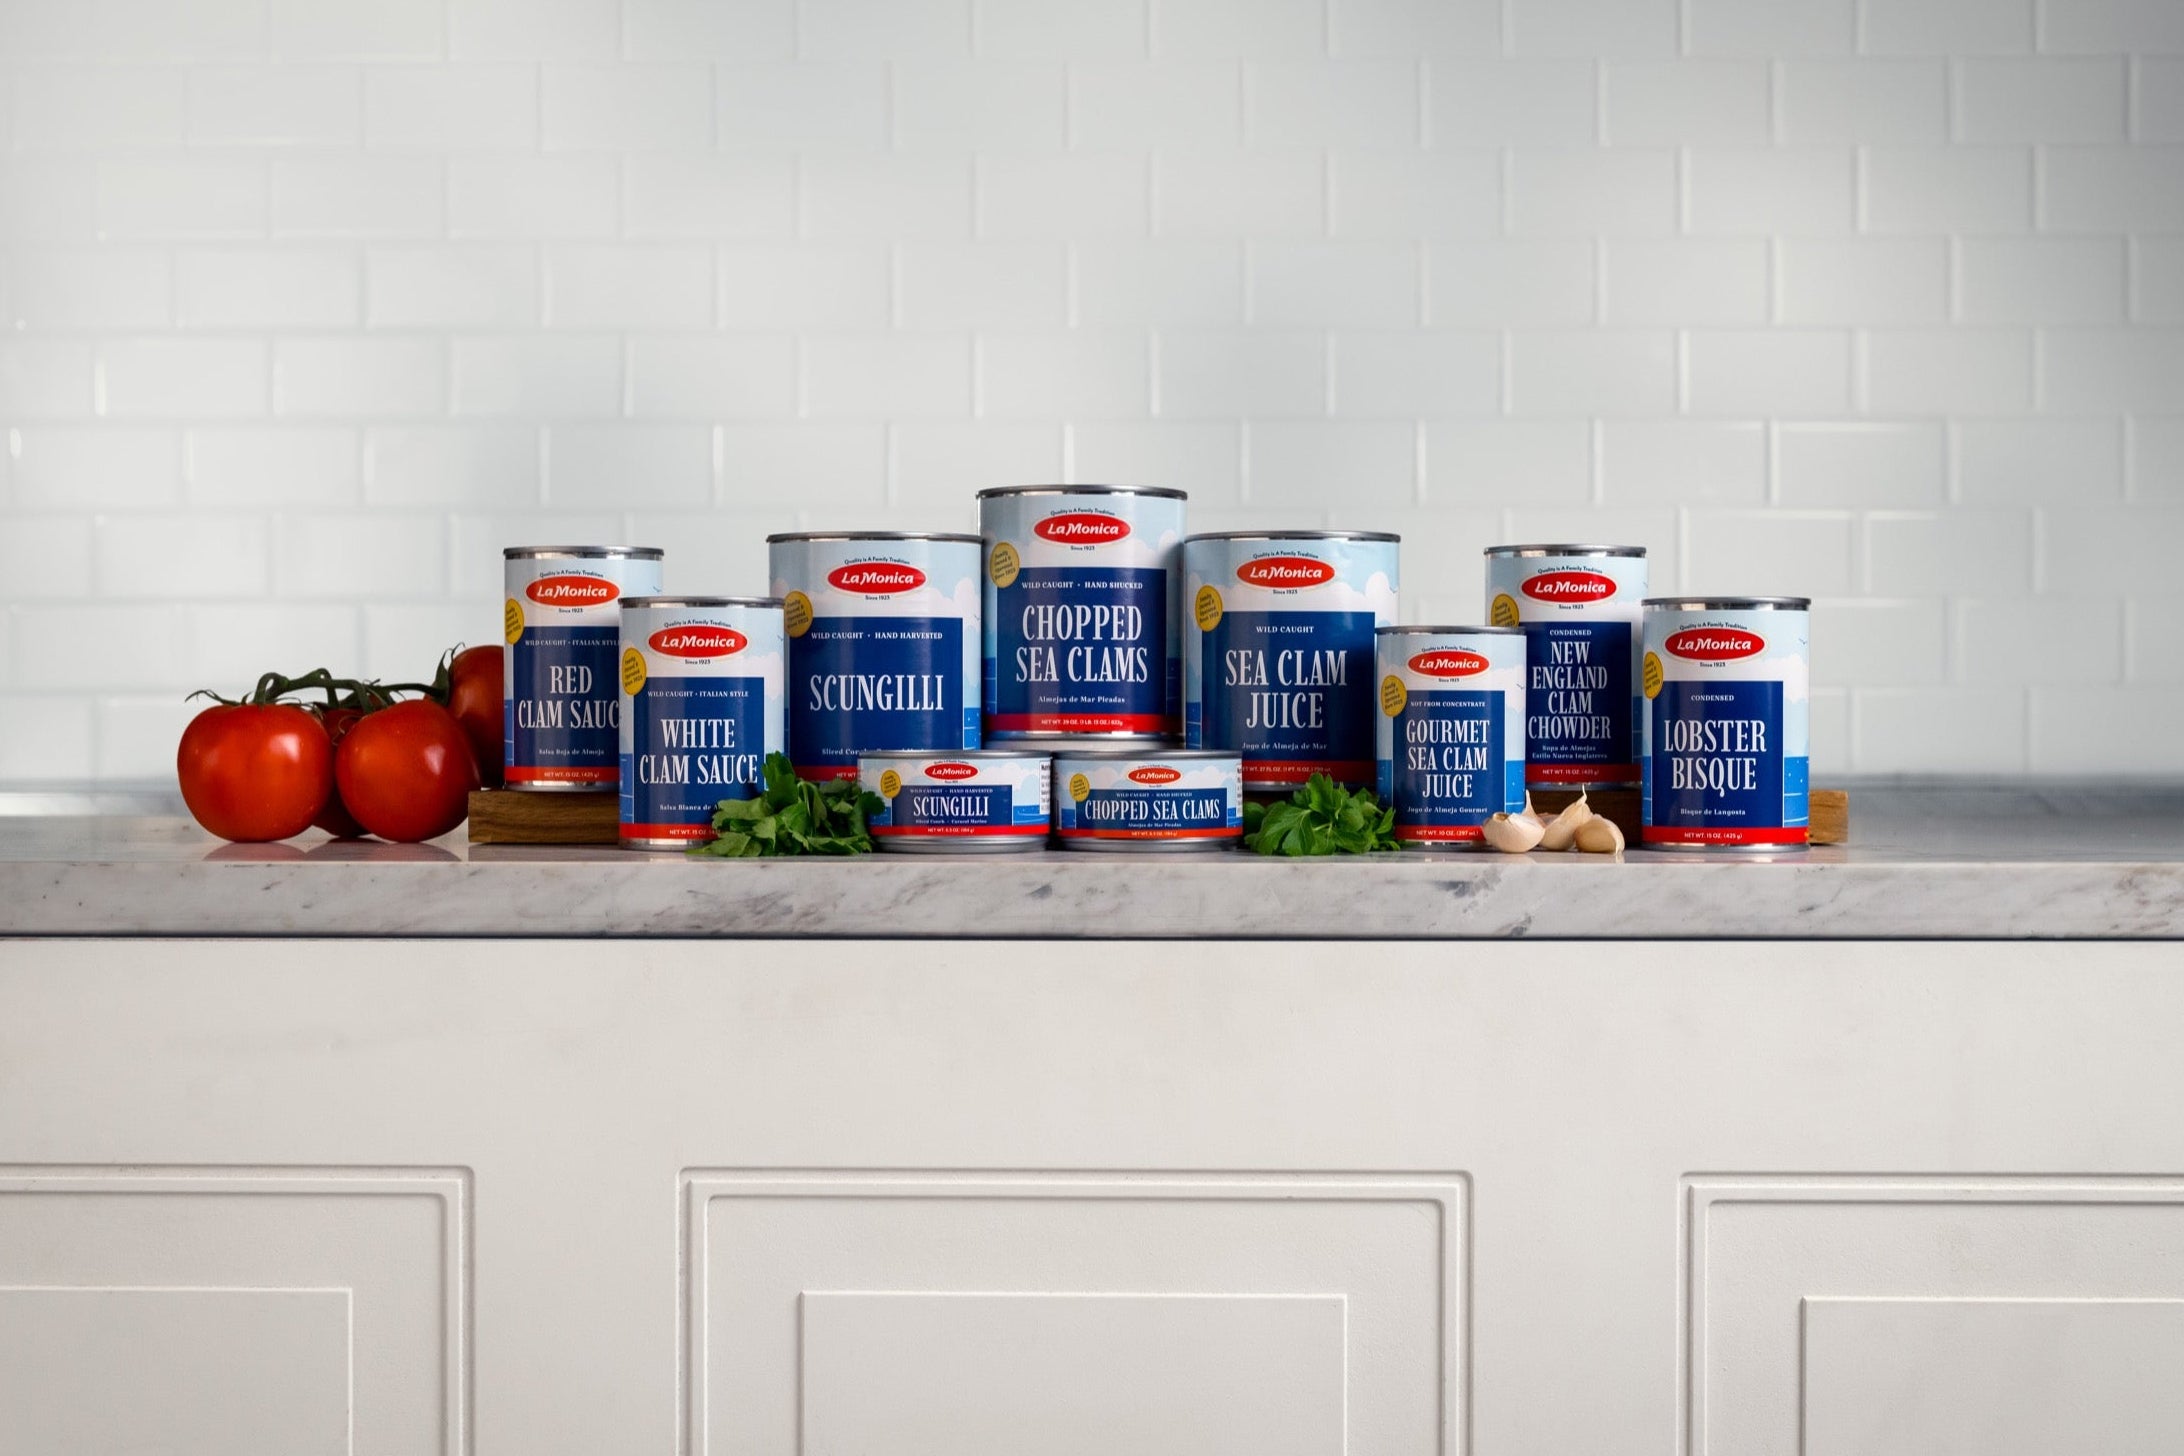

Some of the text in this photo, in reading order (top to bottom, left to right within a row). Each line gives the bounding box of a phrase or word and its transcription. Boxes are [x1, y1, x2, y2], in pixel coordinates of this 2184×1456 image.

[710, 619, 732, 628] Tradition
[1023, 604, 1142, 641] CHOPPED
[1725, 622, 1747, 630] Tradition
[811, 632, 943, 640] WILD CAUGHT HAND HARVESTED
[1016, 646, 1148, 683] SEA CLAMS
[1550, 641, 1590, 664] NEW
[550, 665, 592, 694] RED
[1225, 649, 1347, 686] SEA CLAM
[1532, 666, 1608, 690] ENGLAND
[810, 674, 944, 711] SCUNGILLI
[1039, 696, 1067, 704] Almejas
[1548, 691, 1593, 715] CLAM
[518, 700, 619, 729] CLAM SAUC
[1246, 692, 1323, 728] JUICE
[661, 719, 735, 748] WHITE
[1406, 719, 1490, 744] GOURMET
[1528, 716, 1611, 739] CHOWDER
[1664, 719, 1767, 752] LOBSTER
[1273, 742, 1299, 750] Almeja
[640, 754, 757, 784] CLAM SAUCE
[1408, 747, 1487, 771] SEA CLAM
[1422, 774, 1473, 798] JUICE
[1672, 757, 1756, 798] BISQUE
[913, 796, 989, 817] SCUNGILLI
[1085, 799, 1220, 820] CHOPPED SEA CLAMS
[1681, 808, 1701, 816] Bisque
[1714, 808, 1745, 816] Langosta
